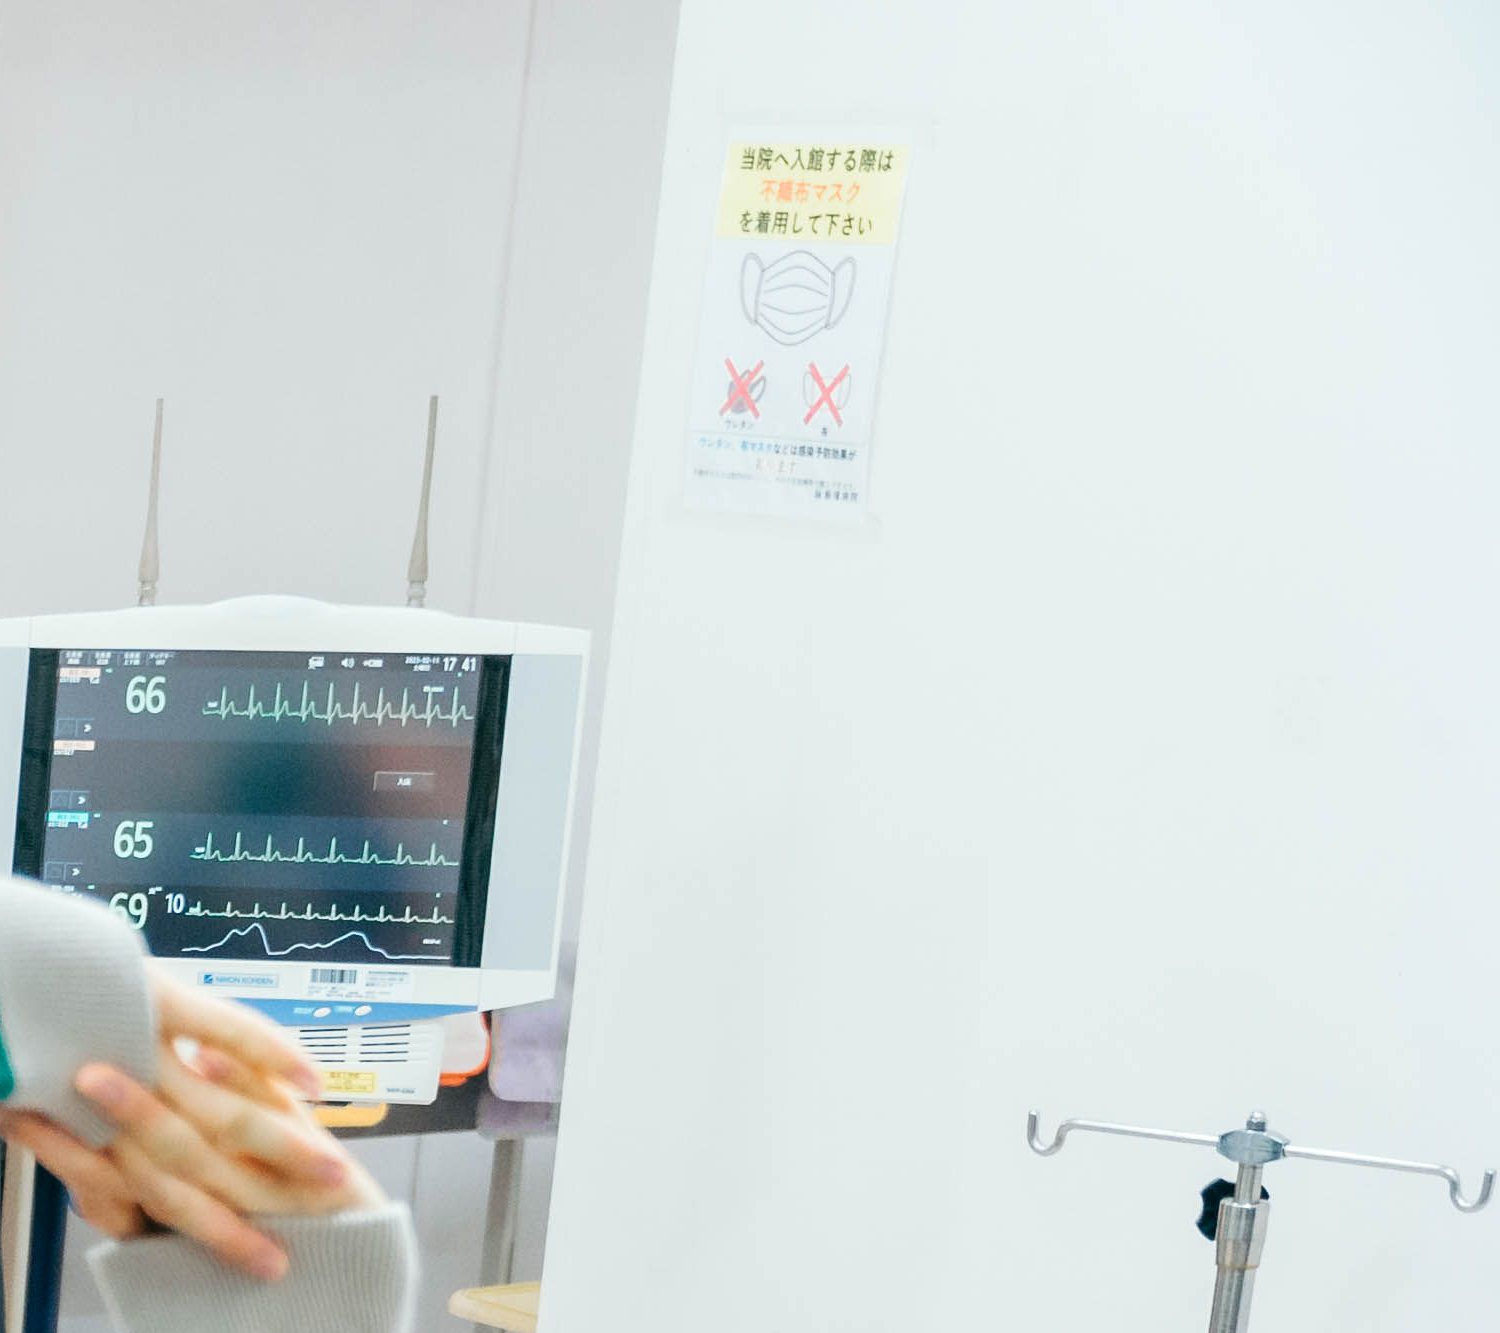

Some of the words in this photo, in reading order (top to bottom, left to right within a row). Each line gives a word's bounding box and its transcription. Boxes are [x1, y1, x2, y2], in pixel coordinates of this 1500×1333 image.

[740, 146, 894, 172] 当院へ入館する際は
[759, 179, 861, 204] 不織布マスク
[739, 211, 873, 237] を着用して下さい
[125, 674, 167, 714] 66
[113, 820, 154, 859] 65
[164, 893, 186, 915] 10
